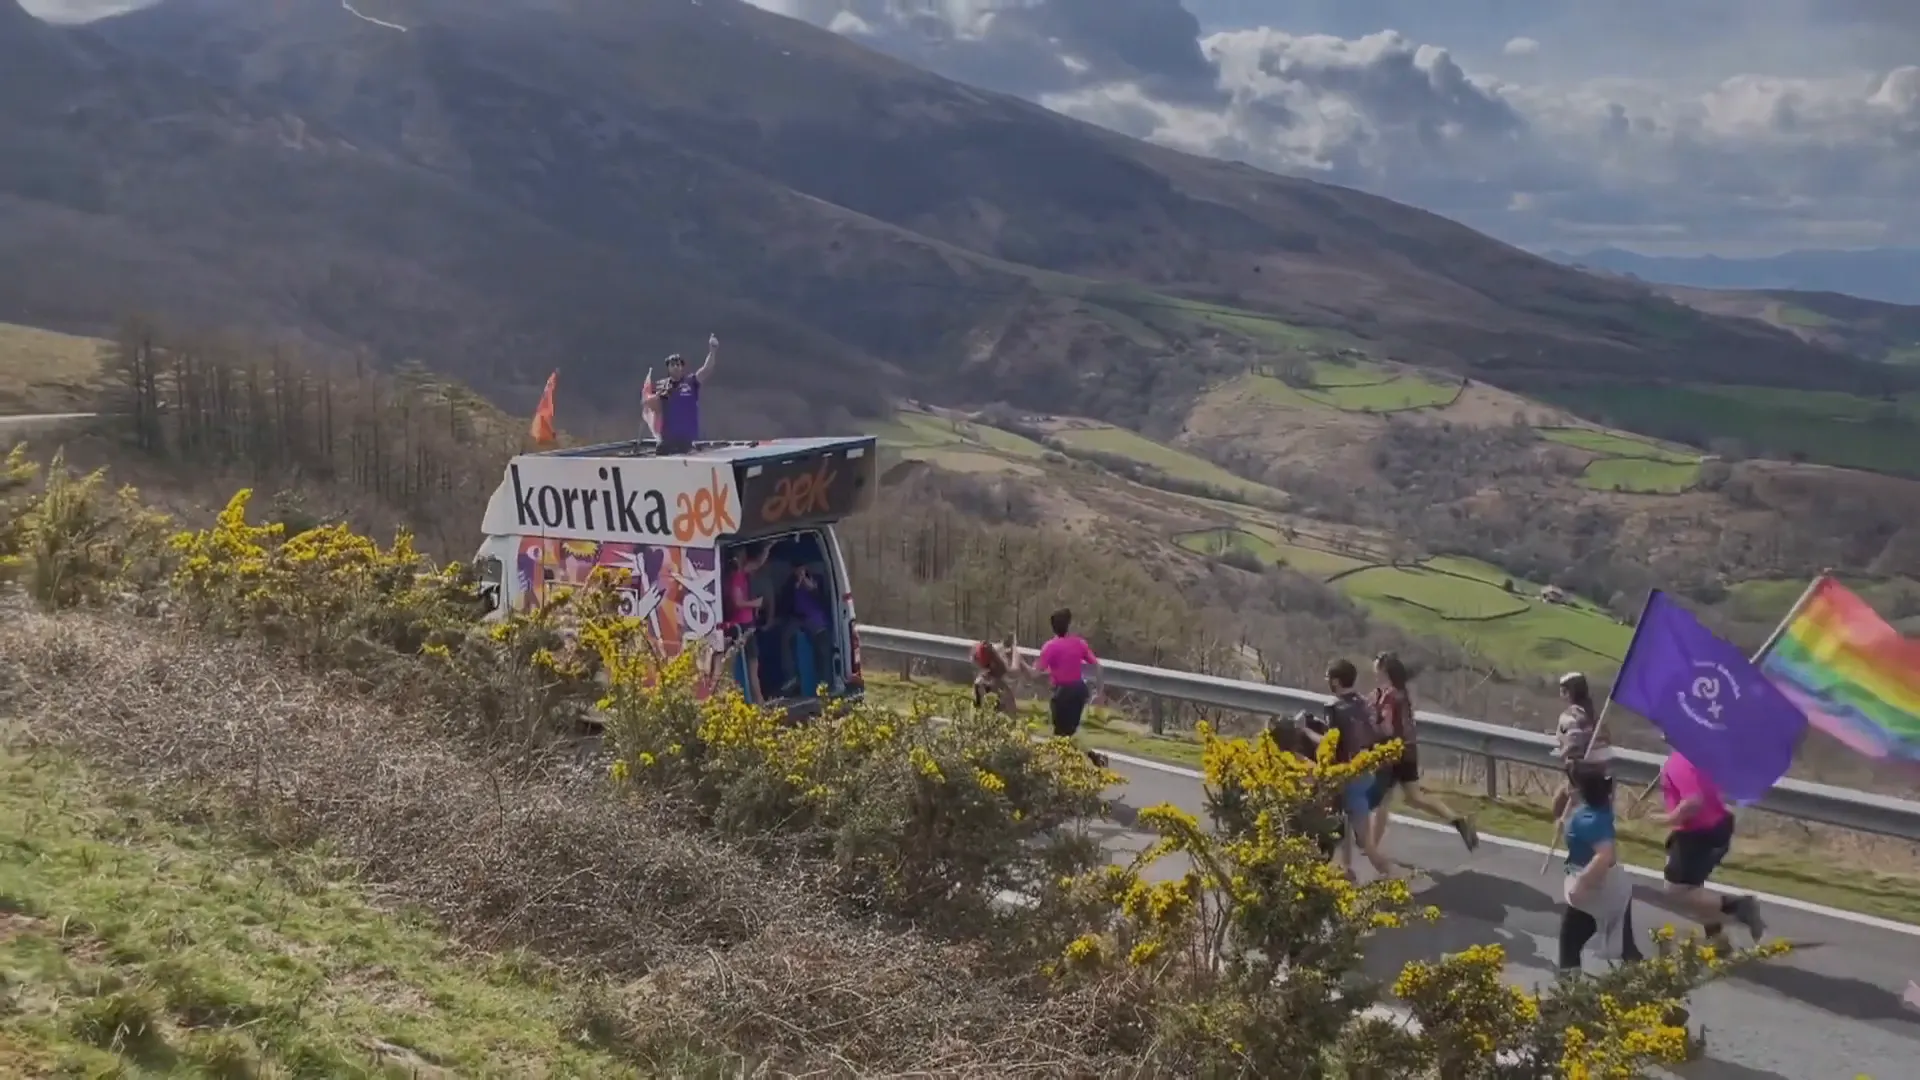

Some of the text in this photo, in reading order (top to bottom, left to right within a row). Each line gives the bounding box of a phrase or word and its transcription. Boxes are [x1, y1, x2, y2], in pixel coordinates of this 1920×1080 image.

[511, 464, 736, 542] korrika aek
[762, 461, 837, 521] aek
